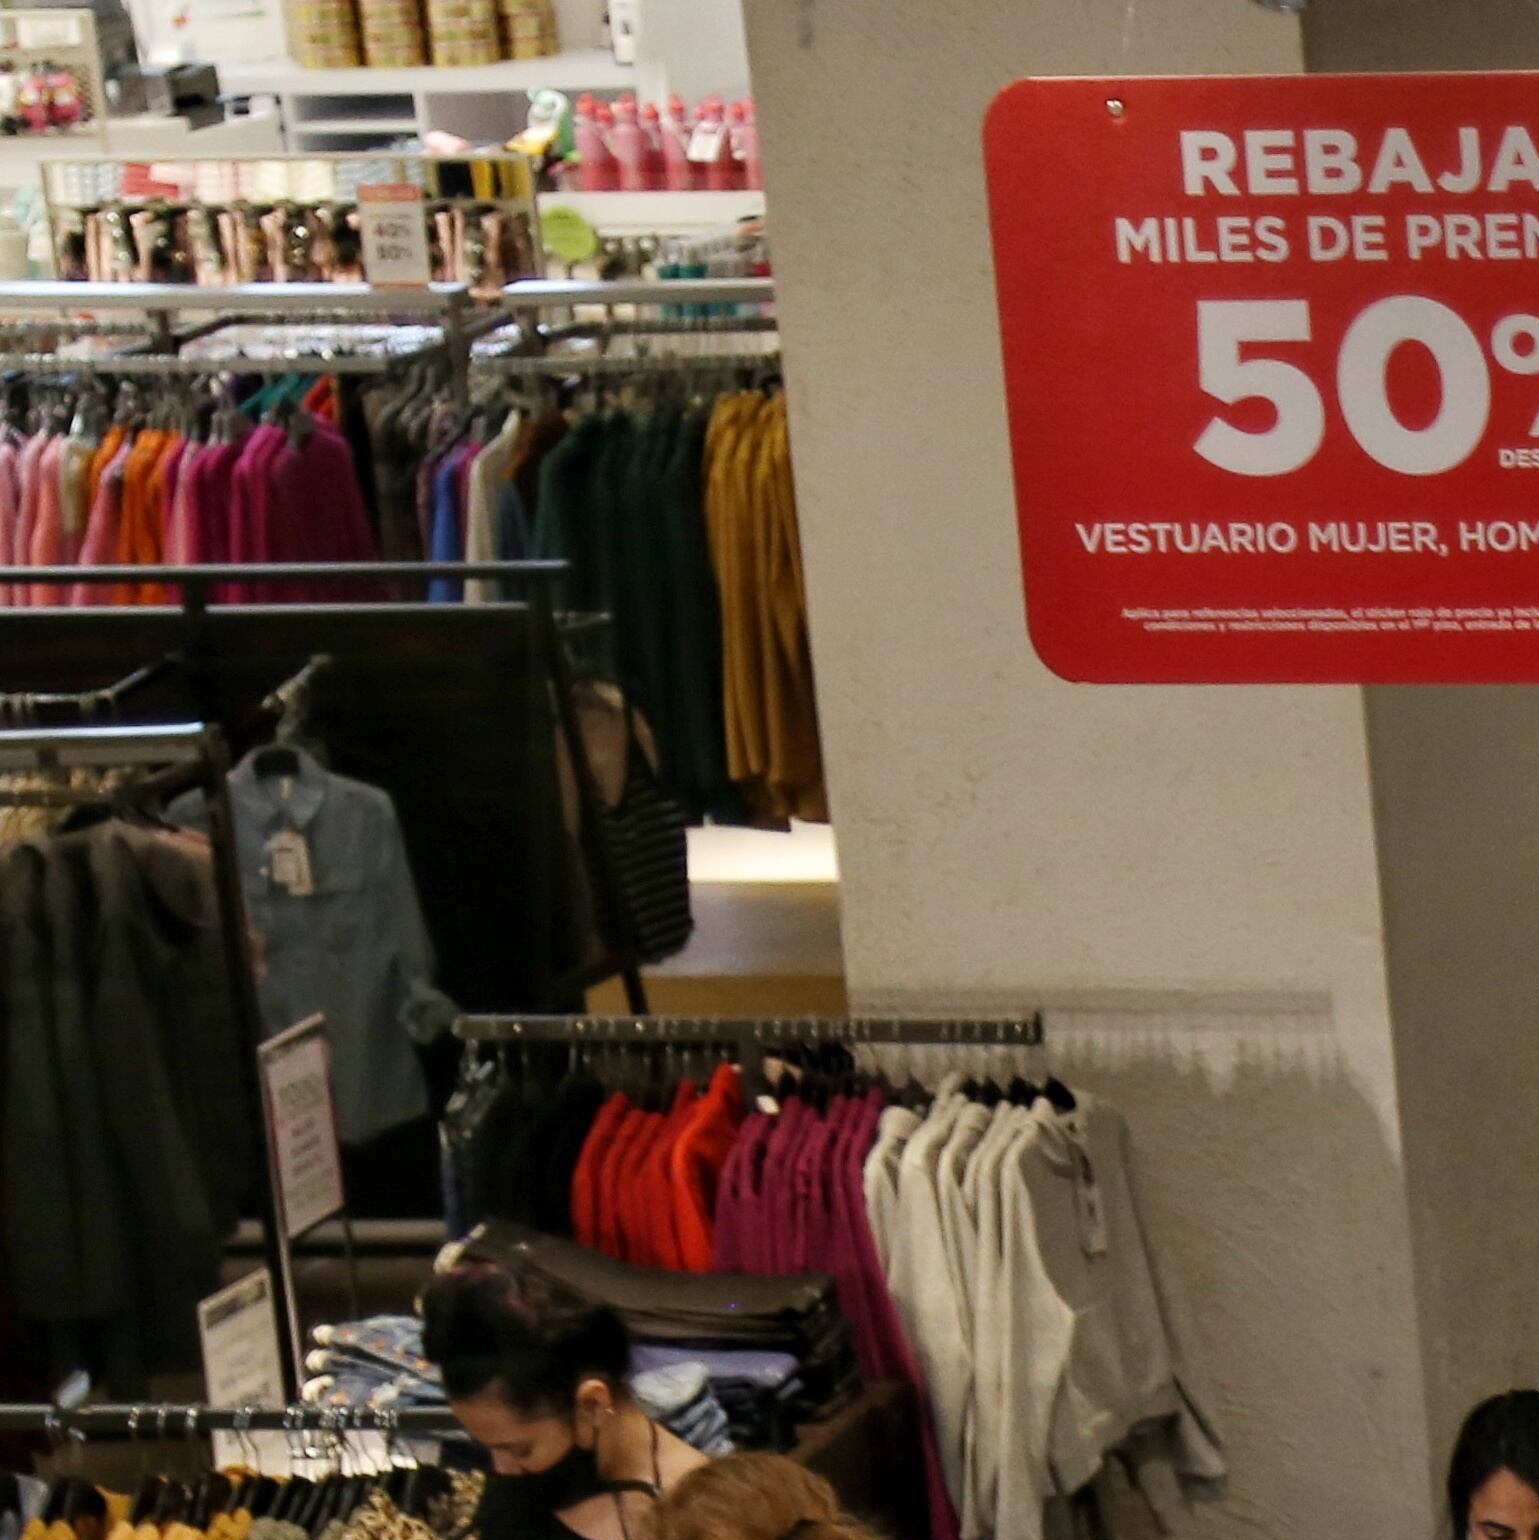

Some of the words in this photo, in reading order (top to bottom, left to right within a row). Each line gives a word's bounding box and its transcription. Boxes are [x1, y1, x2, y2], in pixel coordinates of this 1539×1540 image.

[1115, 216, 1289, 264] MILES
[1309, 216, 1387, 262] DE
[1075, 522, 1298, 554] VESTUARIO
[1308, 521, 1449, 557] MUJER,
